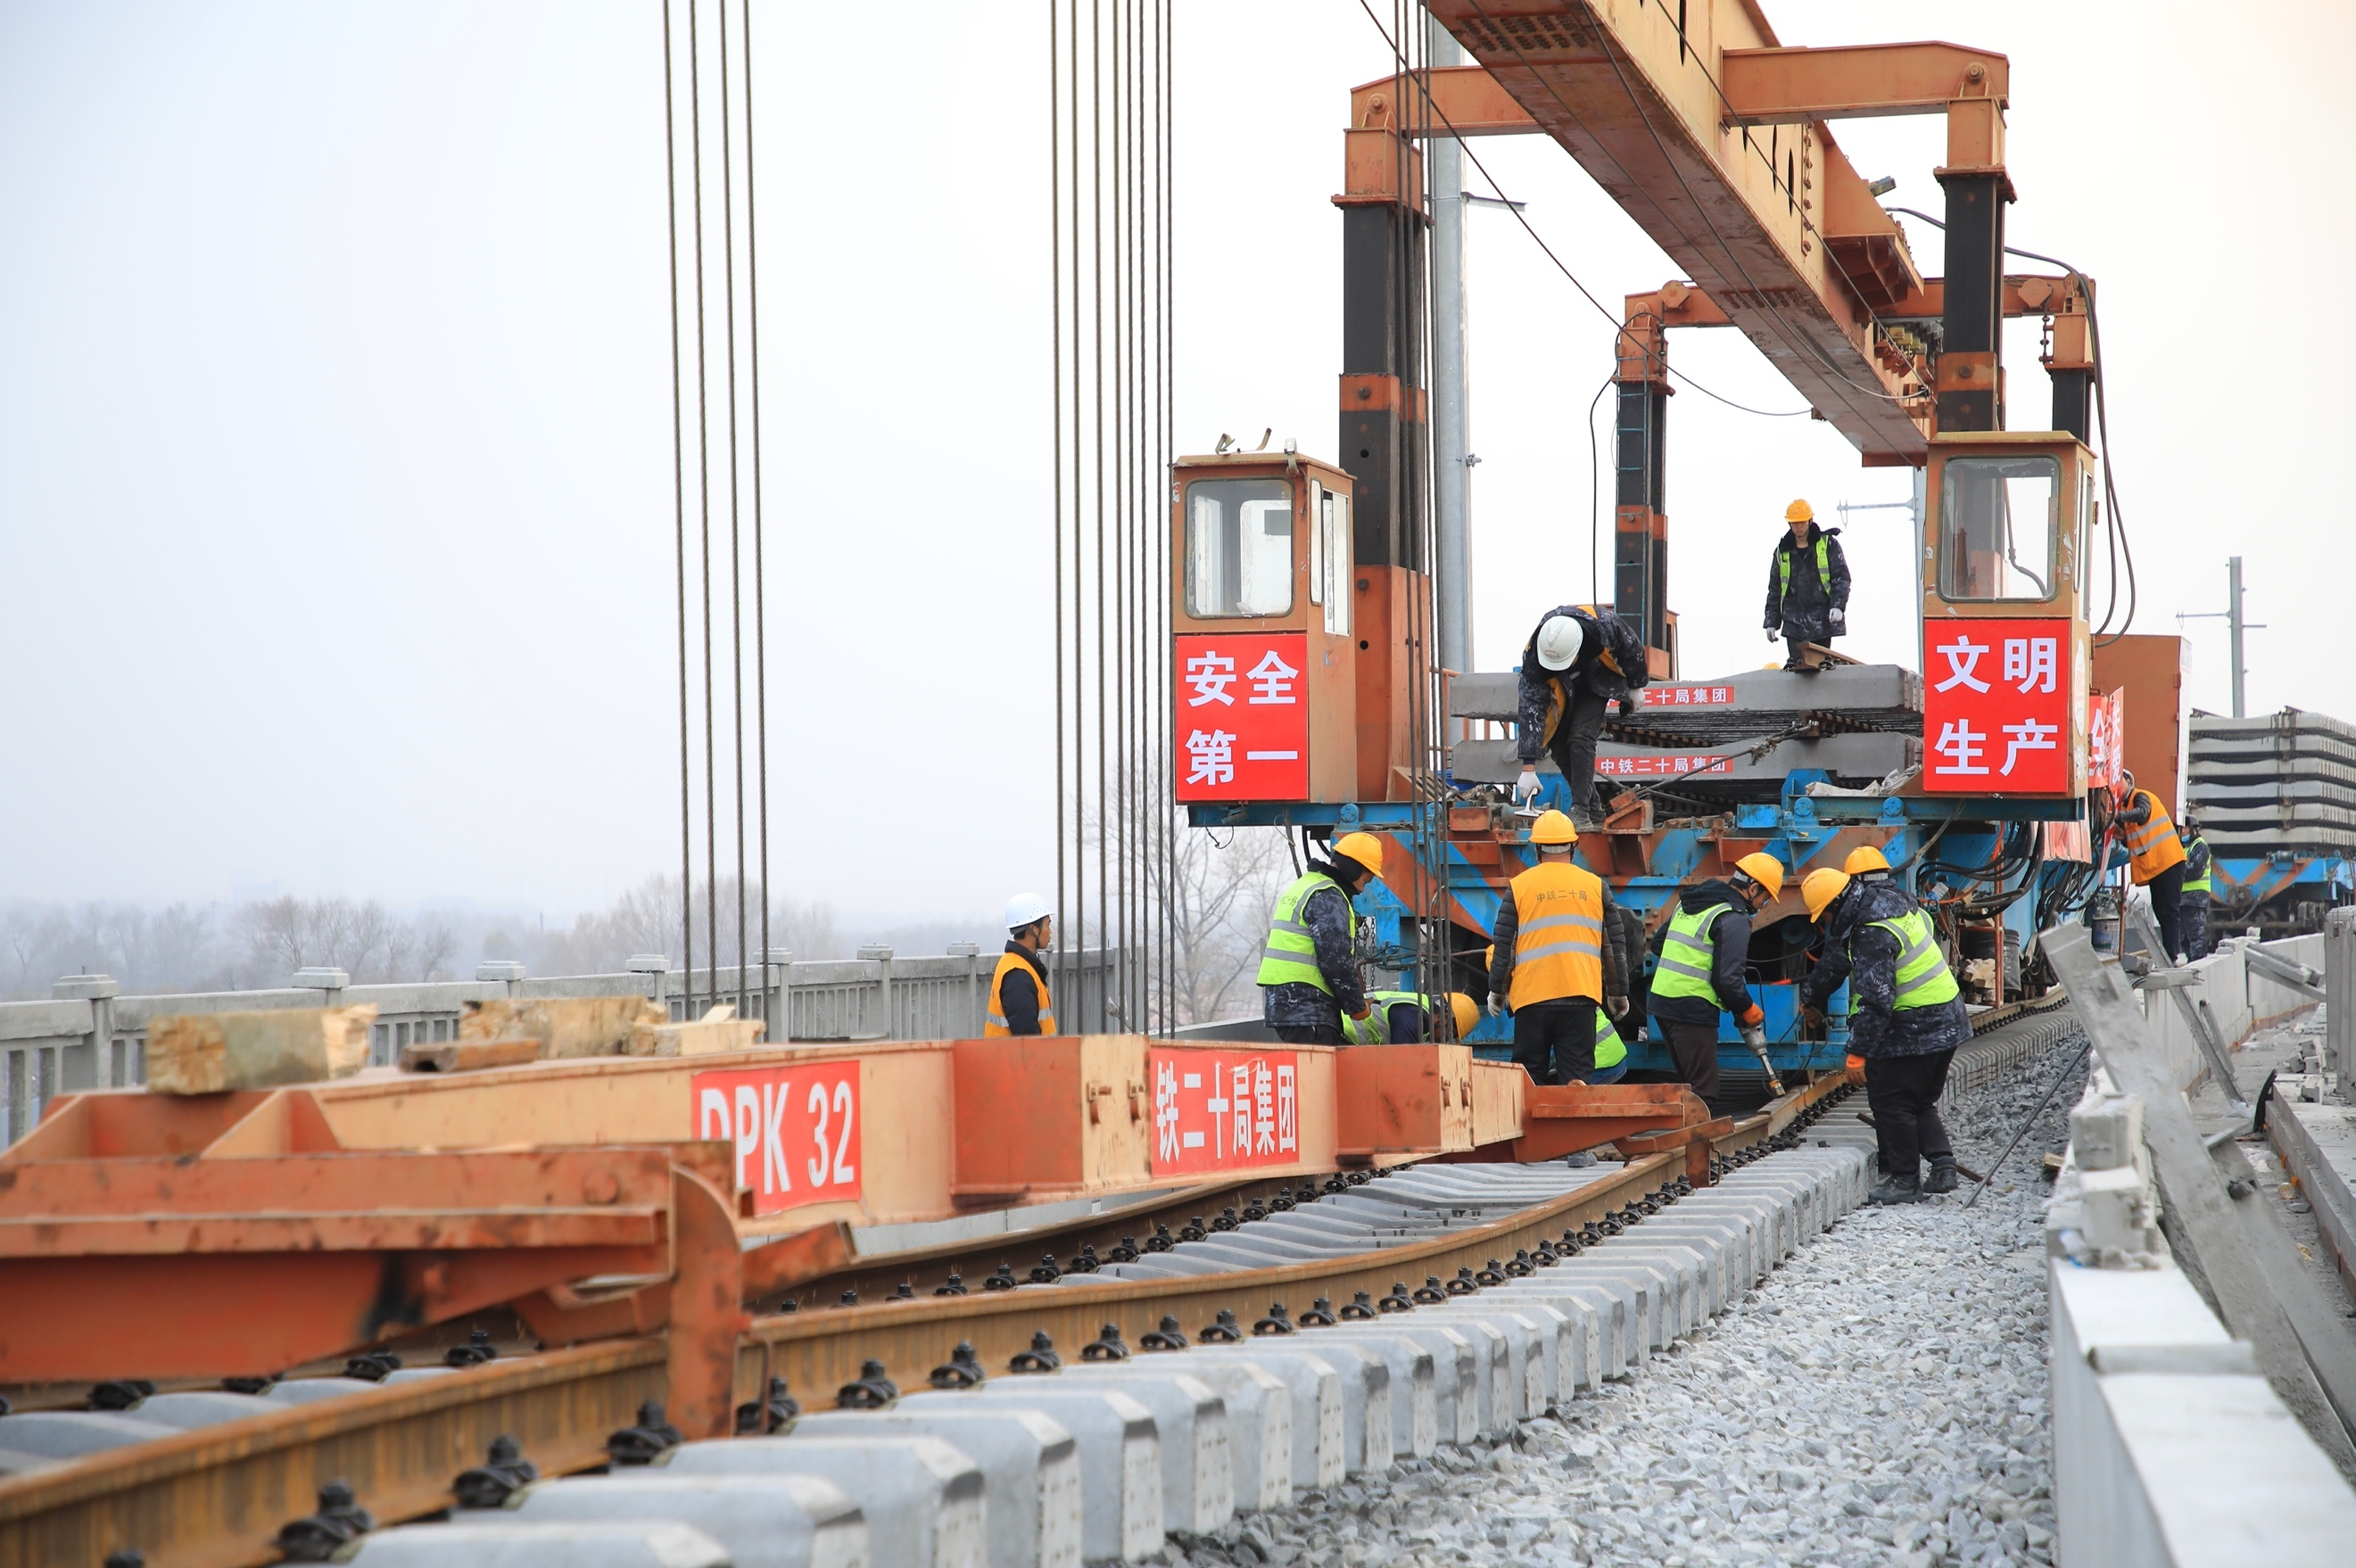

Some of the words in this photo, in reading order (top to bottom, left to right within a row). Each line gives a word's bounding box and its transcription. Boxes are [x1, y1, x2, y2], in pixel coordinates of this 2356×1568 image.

[1185, 649, 1300, 707] 安全
[1934, 635, 2057, 695] 文明
[1608, 688, 1728, 706] 二十局集团
[1185, 729, 1299, 786] 第一
[1600, 757, 1727, 774] 中铁二十局集团
[1934, 717, 2059, 777] 生产
[1536, 888, 1588, 903] 中铁二十局
[807, 1080, 854, 1188] 32
